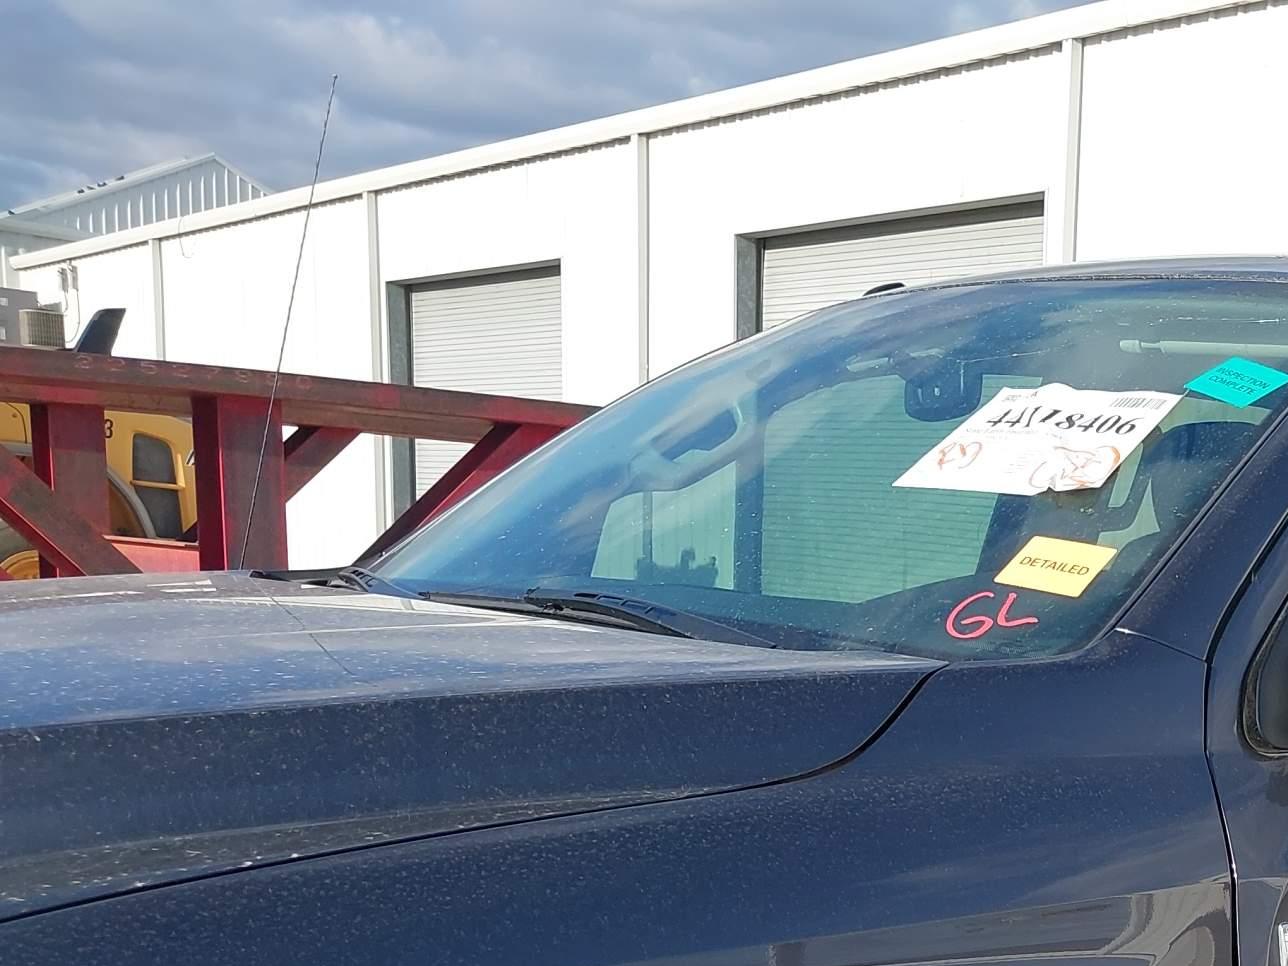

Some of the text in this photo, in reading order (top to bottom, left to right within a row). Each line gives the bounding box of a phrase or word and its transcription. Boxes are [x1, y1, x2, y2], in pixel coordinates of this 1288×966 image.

[1208, 375, 1258, 396] COMPLETE
[1216, 366, 1271, 390] INSPECTION
[985, 404, 1145, 436] 44118406
[1018, 555, 1091, 577] DETAILED
[945, 591, 1040, 640] GL
